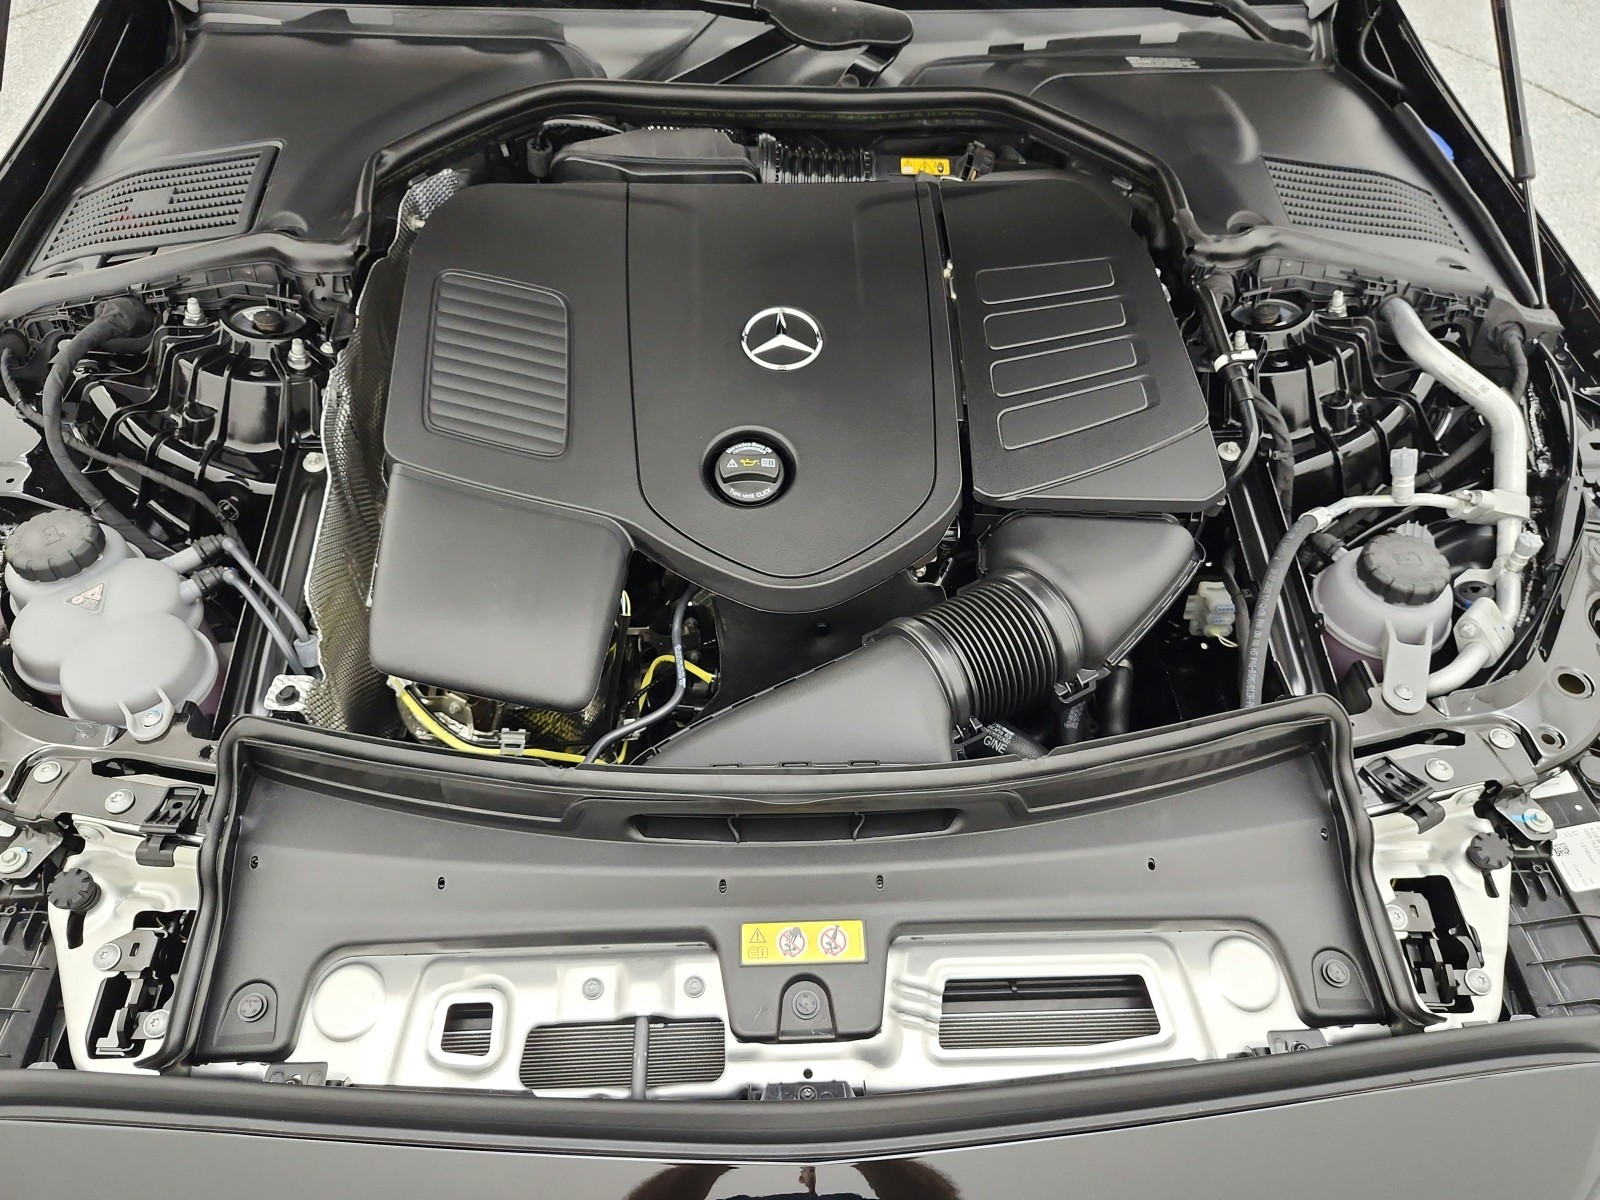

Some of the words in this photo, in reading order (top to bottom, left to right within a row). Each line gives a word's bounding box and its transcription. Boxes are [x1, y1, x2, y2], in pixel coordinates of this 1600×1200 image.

[730, 487, 741, 497] Turn
[756, 487, 773, 498] CLICK
[984, 735, 1008, 755] GINE
